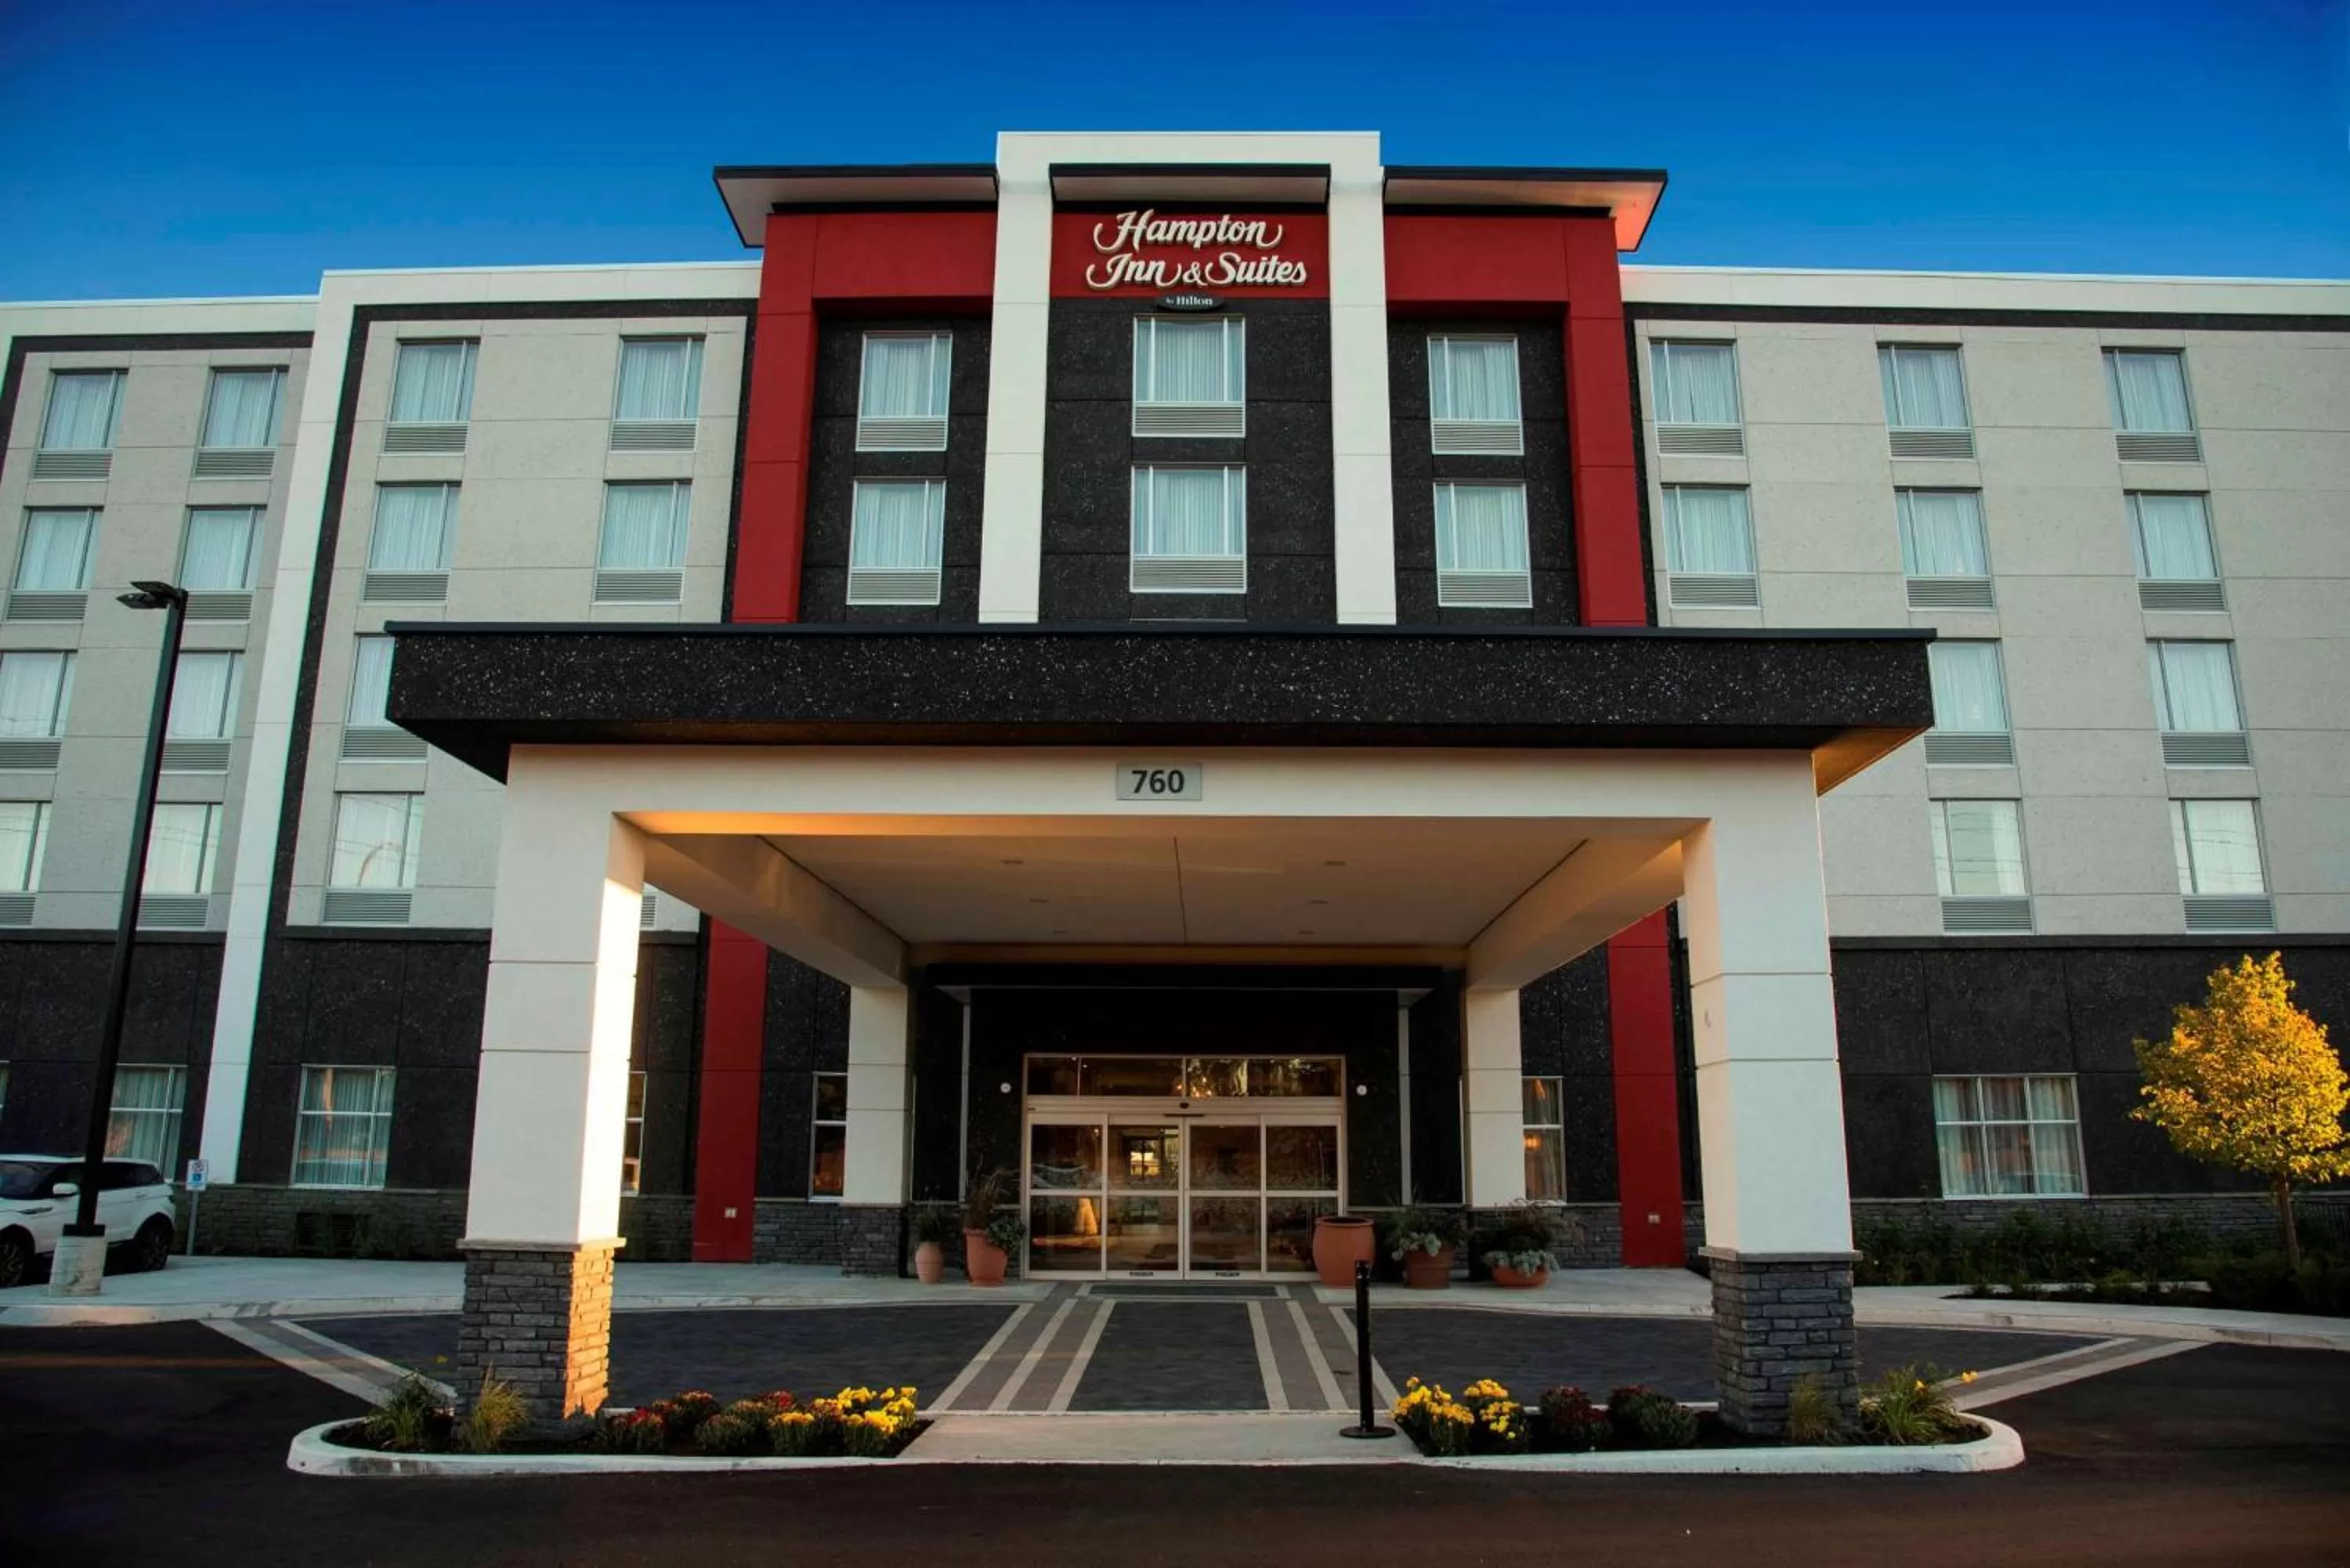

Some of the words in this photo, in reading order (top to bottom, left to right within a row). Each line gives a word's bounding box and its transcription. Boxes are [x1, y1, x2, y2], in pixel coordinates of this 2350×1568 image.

[1094, 208, 1283, 251] Hampton
[1086, 253, 1181, 288] Inn
[1182, 261, 1208, 286] &
[1205, 251, 1307, 285] Suites
[1177, 295, 1213, 306] Hilton
[1131, 770, 1184, 793] 760
